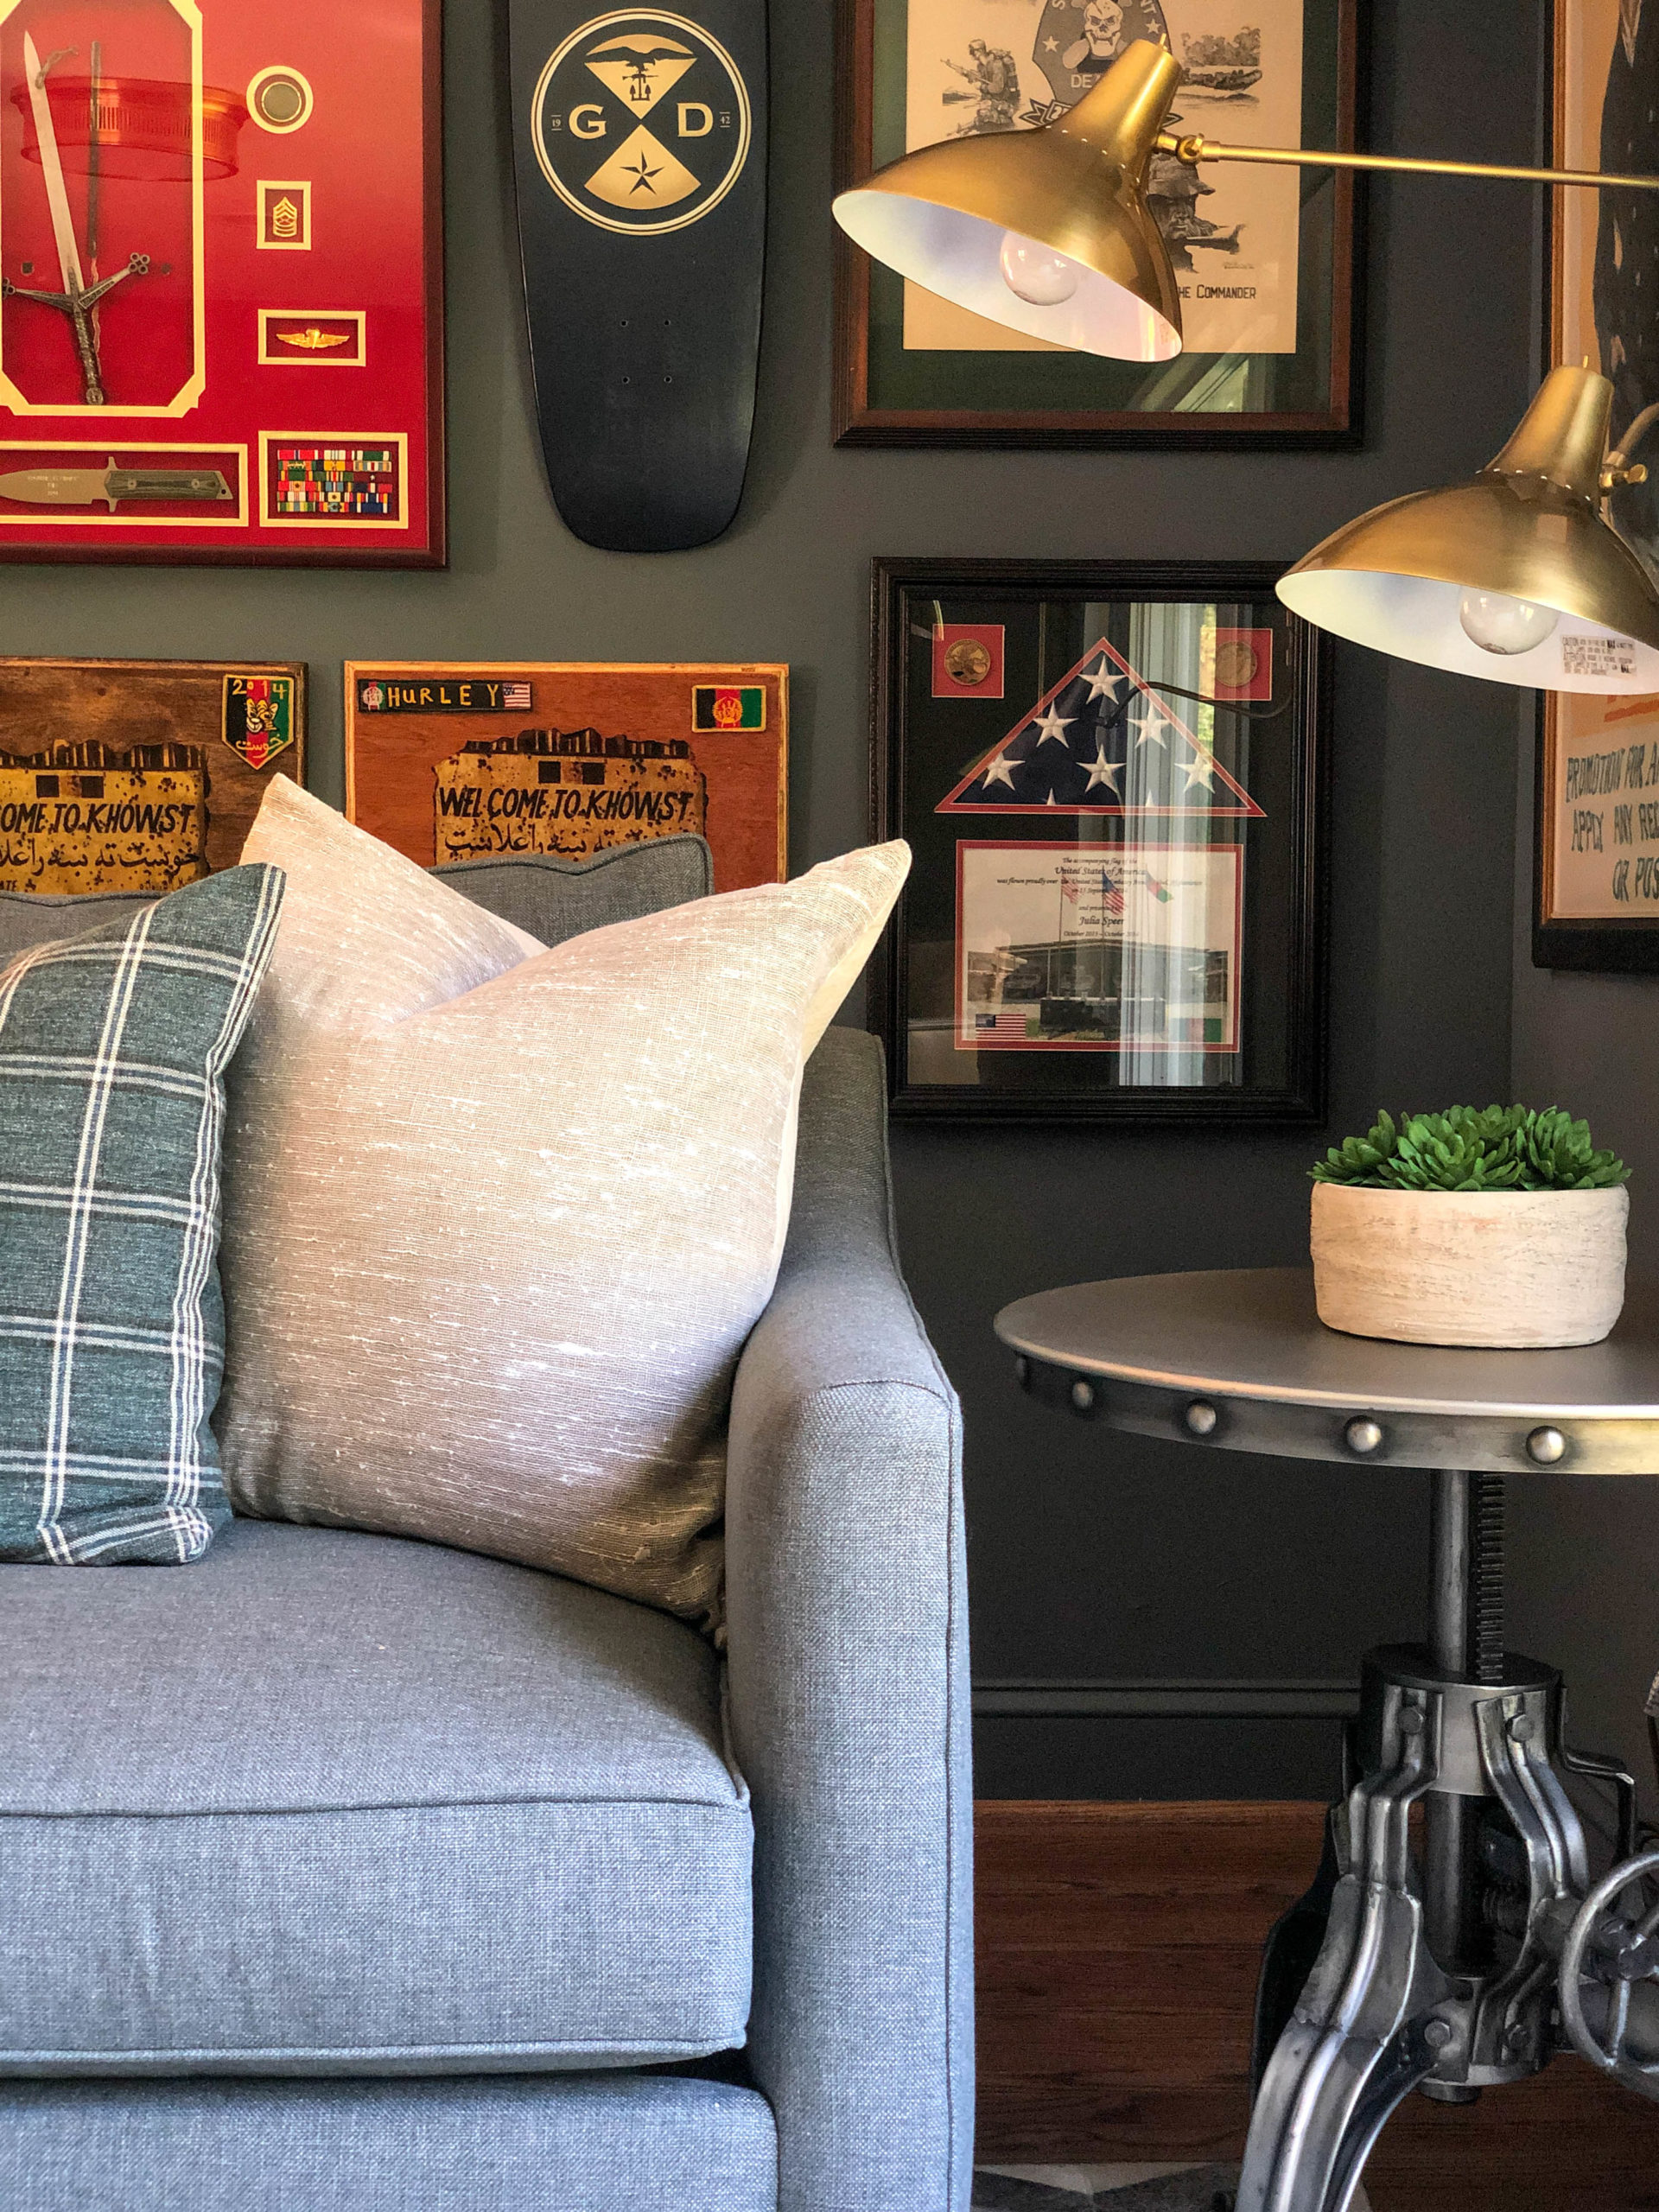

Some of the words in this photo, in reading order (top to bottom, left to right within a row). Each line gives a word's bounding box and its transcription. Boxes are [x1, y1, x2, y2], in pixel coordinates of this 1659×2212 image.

[551, 118, 562, 127] 19
[569, 103, 607, 140] G
[677, 102, 714, 137] D
[720, 116, 730, 124] 42
[1177, 286, 1192, 299] HE
[1196, 284, 1256, 299] COMMANDER
[232, 679, 288, 700] 2014
[1566, 747, 1625, 804] PROMOTION
[0, 803, 48, 834] OME
[54, 803, 81, 834] TO
[85, 803, 196, 834] KHOWST
[555, 789, 582, 820] TO
[585, 789, 694, 822] KHOWST
[1571, 809, 1605, 853] APPLY
[1613, 803, 1633, 847] ANY
[1055, 866, 1080, 874] United
[1082, 867, 1104, 875] States
[1106, 867, 1116, 878] of
[1612, 858, 1630, 902] OR
[1078, 916, 1101, 926] Julia
